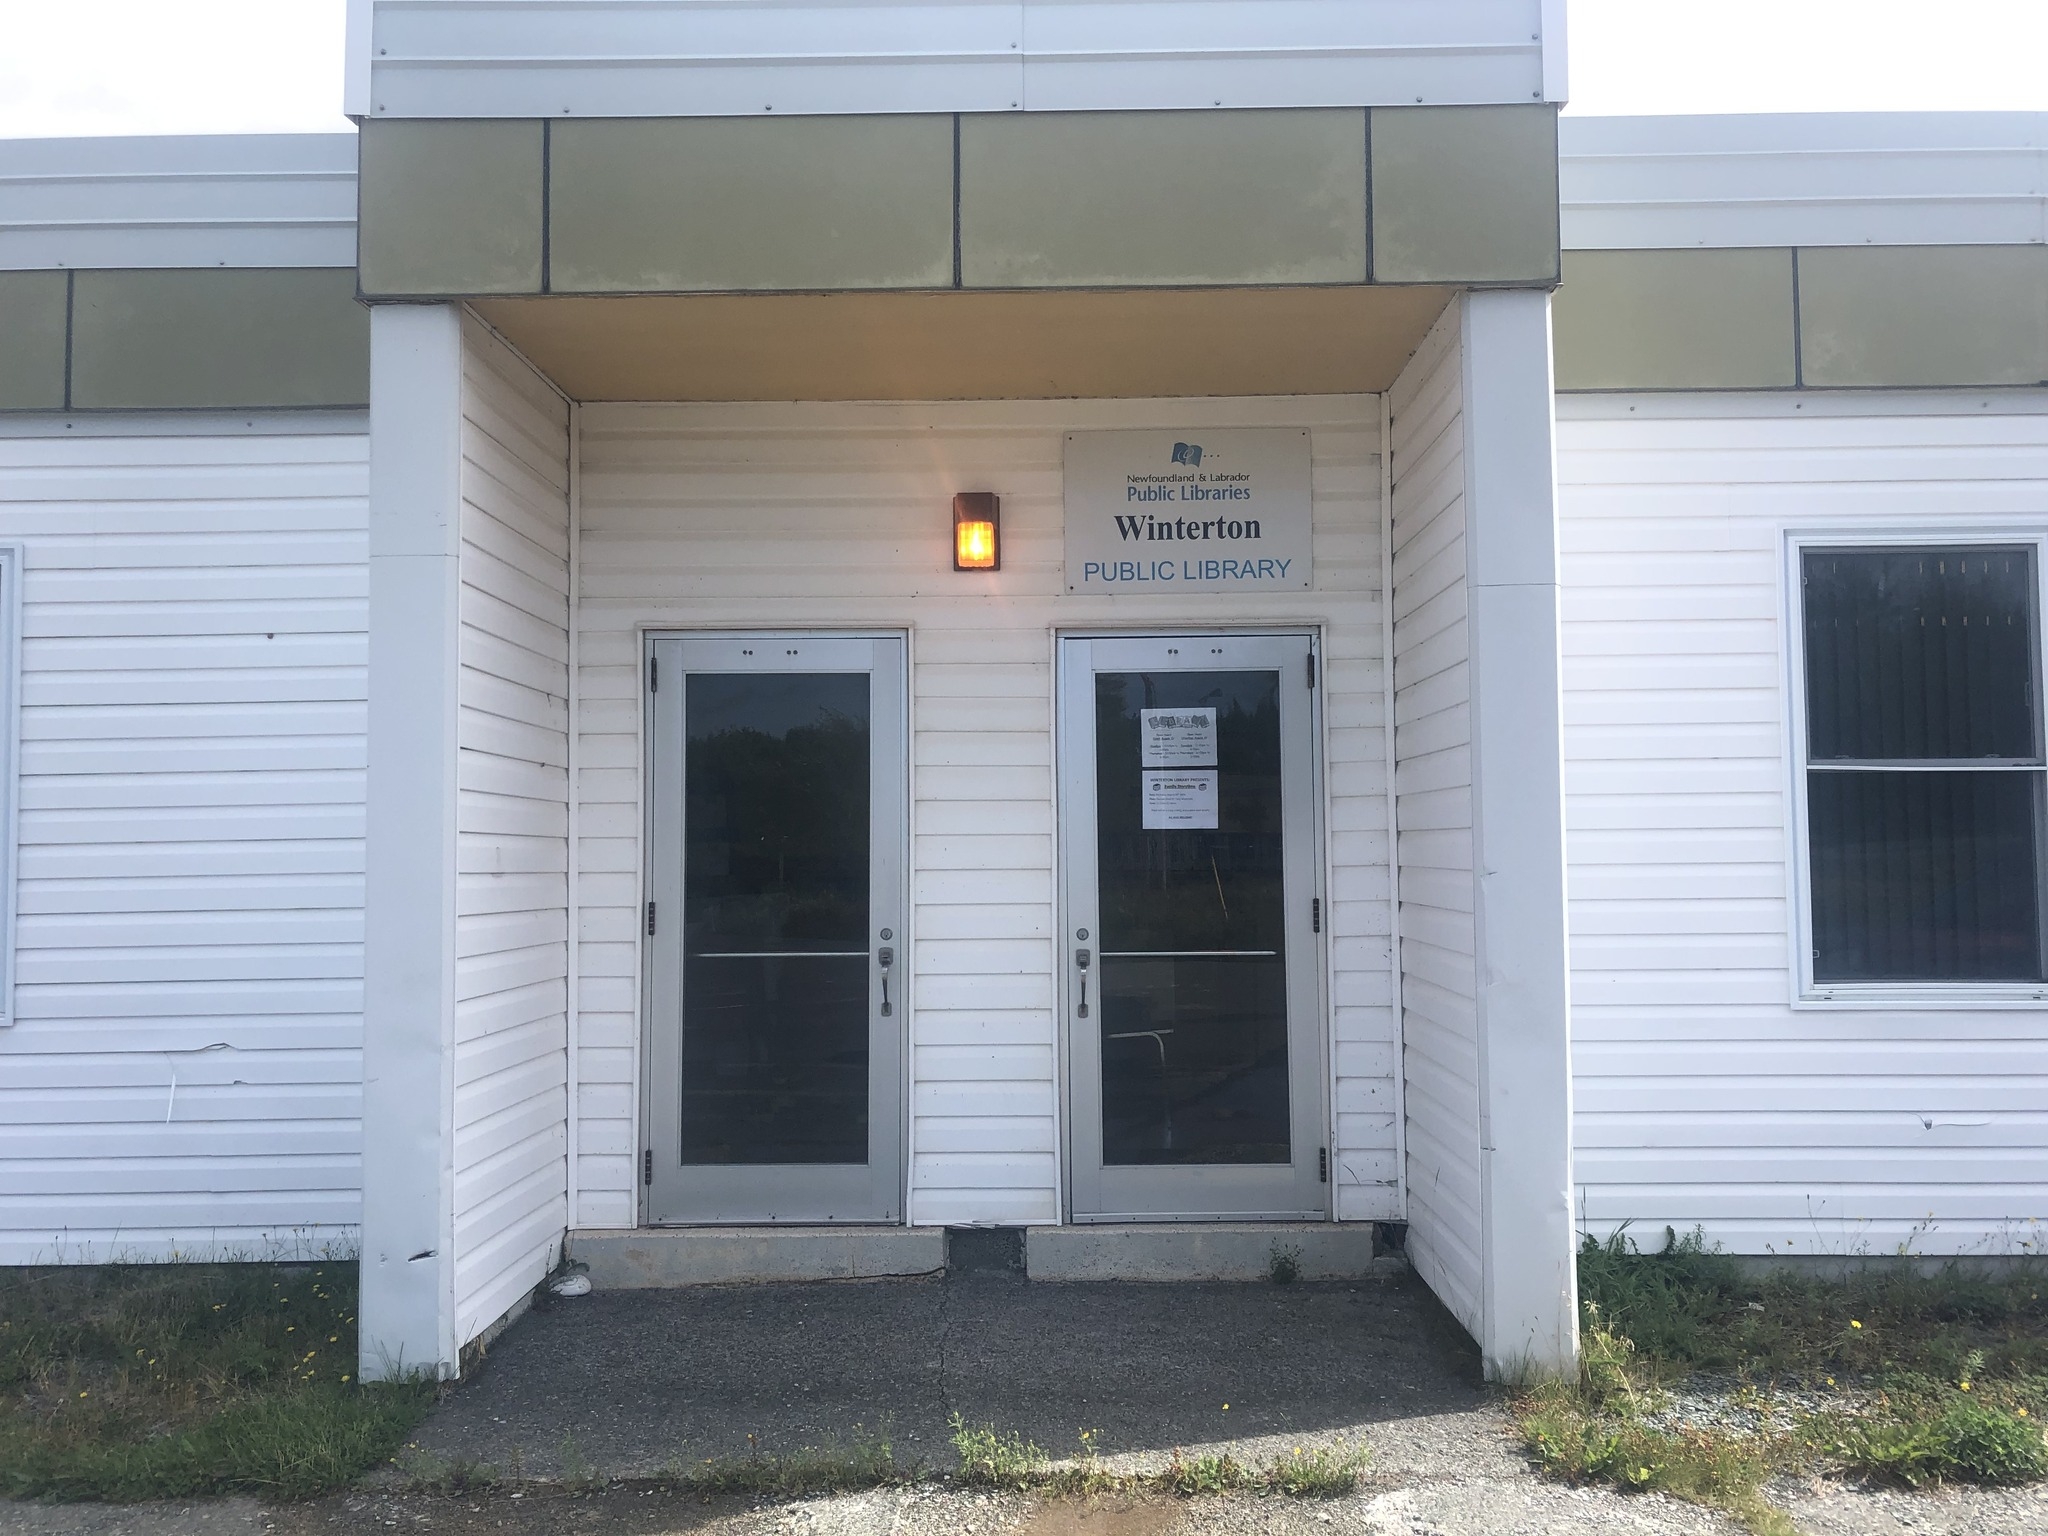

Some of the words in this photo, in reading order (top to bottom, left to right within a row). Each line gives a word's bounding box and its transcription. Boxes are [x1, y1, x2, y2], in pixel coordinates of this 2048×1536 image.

[1127, 473, 1195, 483] Newfoundland
[1199, 474, 1206, 482] &
[1210, 473, 1250, 482] Labrador
[1127, 485, 1175, 502] Public
[1181, 484, 1250, 501] Libraries
[1114, 514, 1261, 541] Winterton
[1084, 560, 1175, 581] PUBLIC
[1184, 558, 1292, 580] LIBRARY
